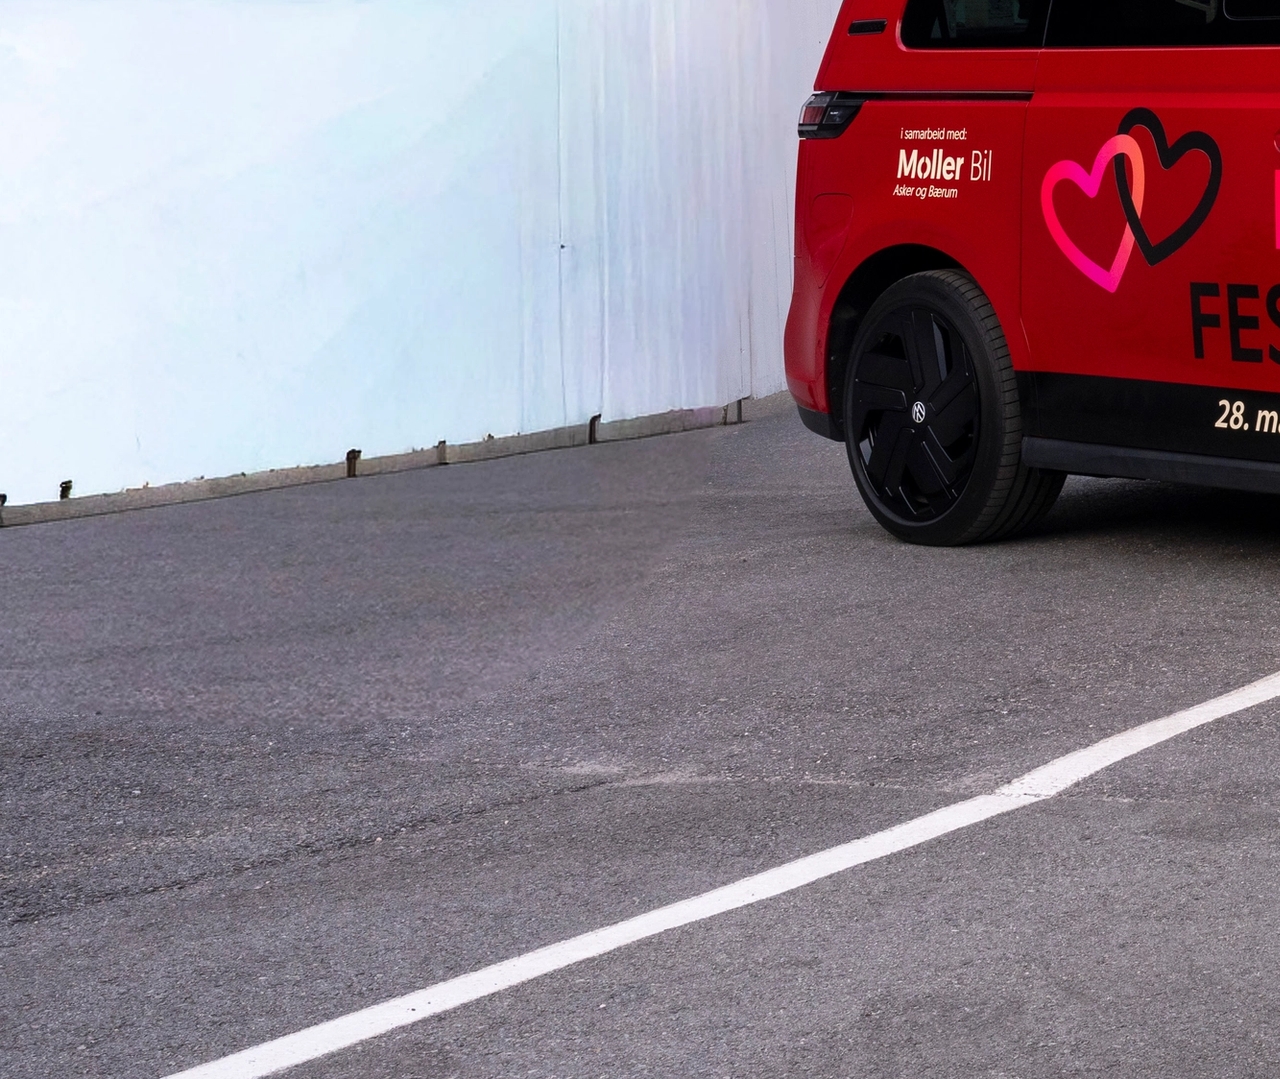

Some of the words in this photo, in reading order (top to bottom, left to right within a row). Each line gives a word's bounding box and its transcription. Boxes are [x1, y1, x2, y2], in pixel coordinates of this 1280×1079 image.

[904, 127, 945, 140] samarbeid
[946, 127, 968, 140] med:
[970, 149, 993, 182] Bil
[893, 184, 915, 197] Asker
[915, 187, 928, 200] og
[928, 185, 958, 199] Bærum
[1214, 399, 1250, 431] 28.
